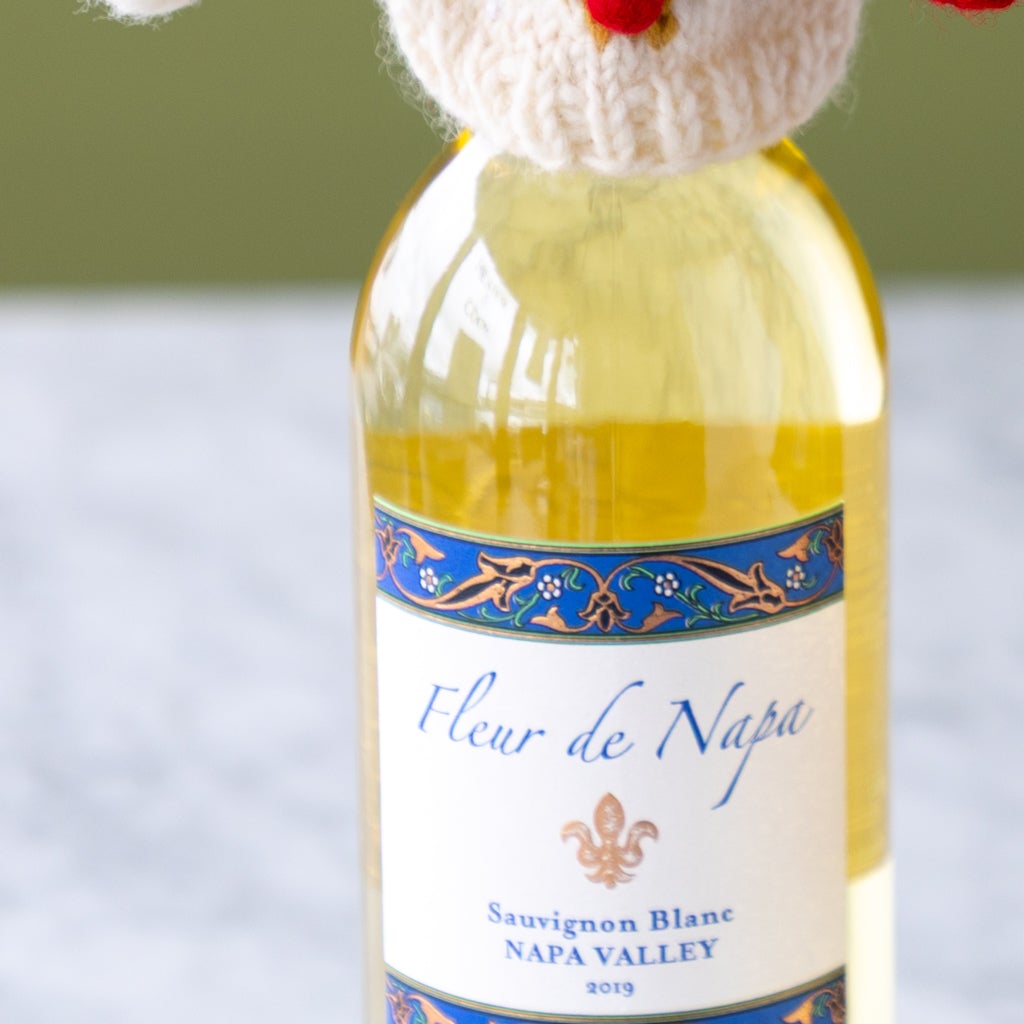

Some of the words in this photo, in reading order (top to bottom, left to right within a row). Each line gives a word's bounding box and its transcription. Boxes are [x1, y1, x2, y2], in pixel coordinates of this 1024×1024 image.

[417, 670, 547, 756] Fleur
[565, 680, 645, 764] de
[655, 680, 815, 811] Napa
[487, 901, 638, 940] Sauvignon
[648, 907, 735, 932] Blanc
[504, 938, 587, 967] NAPA
[592, 937, 720, 967] VALLEY
[585, 981, 636, 998] 2019
